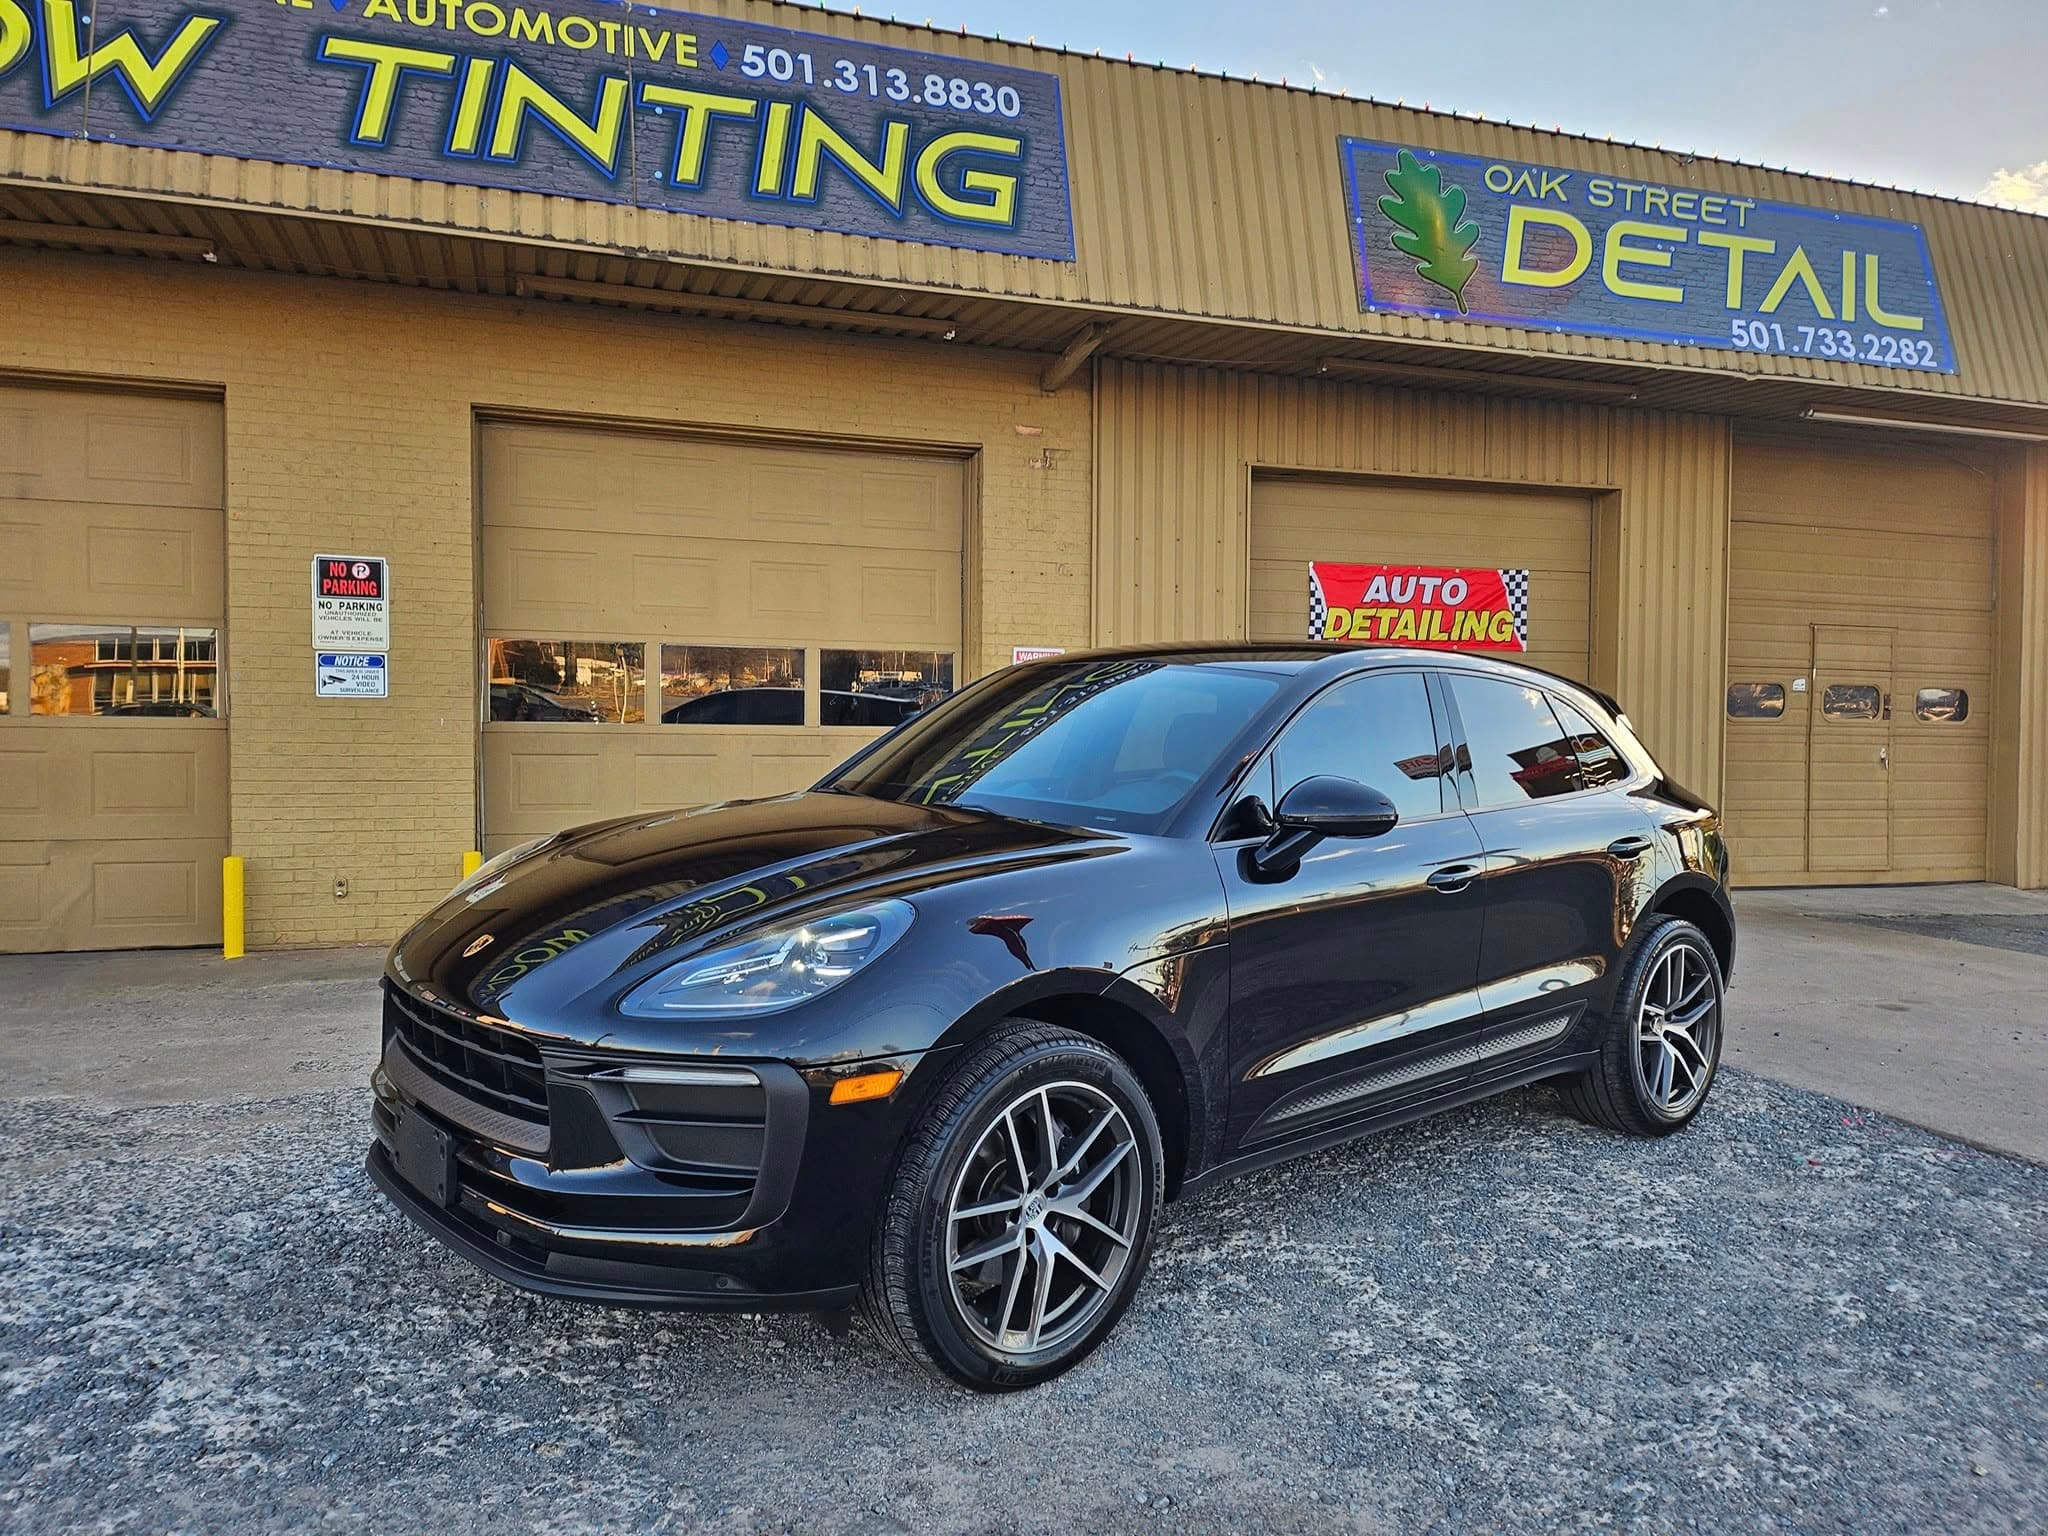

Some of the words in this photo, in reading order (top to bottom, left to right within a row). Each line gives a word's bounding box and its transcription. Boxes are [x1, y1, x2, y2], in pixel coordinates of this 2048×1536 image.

[363, 0, 698, 68] AUTOMOTIVE
[739, 44, 1021, 118] 501.313.8830
[320, 36, 1023, 228] TINTING
[1482, 163, 1572, 203] OAK
[1587, 178, 1756, 228] STREET
[1501, 204, 1924, 331] DETAIL
[1730, 318, 1938, 369] 501.733.2282
[329, 561, 347, 578] NO
[323, 578, 378, 597] PARKING
[1362, 575, 1469, 605] AUTO
[318, 600, 333, 610] NO
[338, 601, 383, 612] PARKING
[1322, 607, 1515, 642] DETAILING
[334, 655, 370, 667] NOTICE
[1019, 651, 1058, 661] WARN
